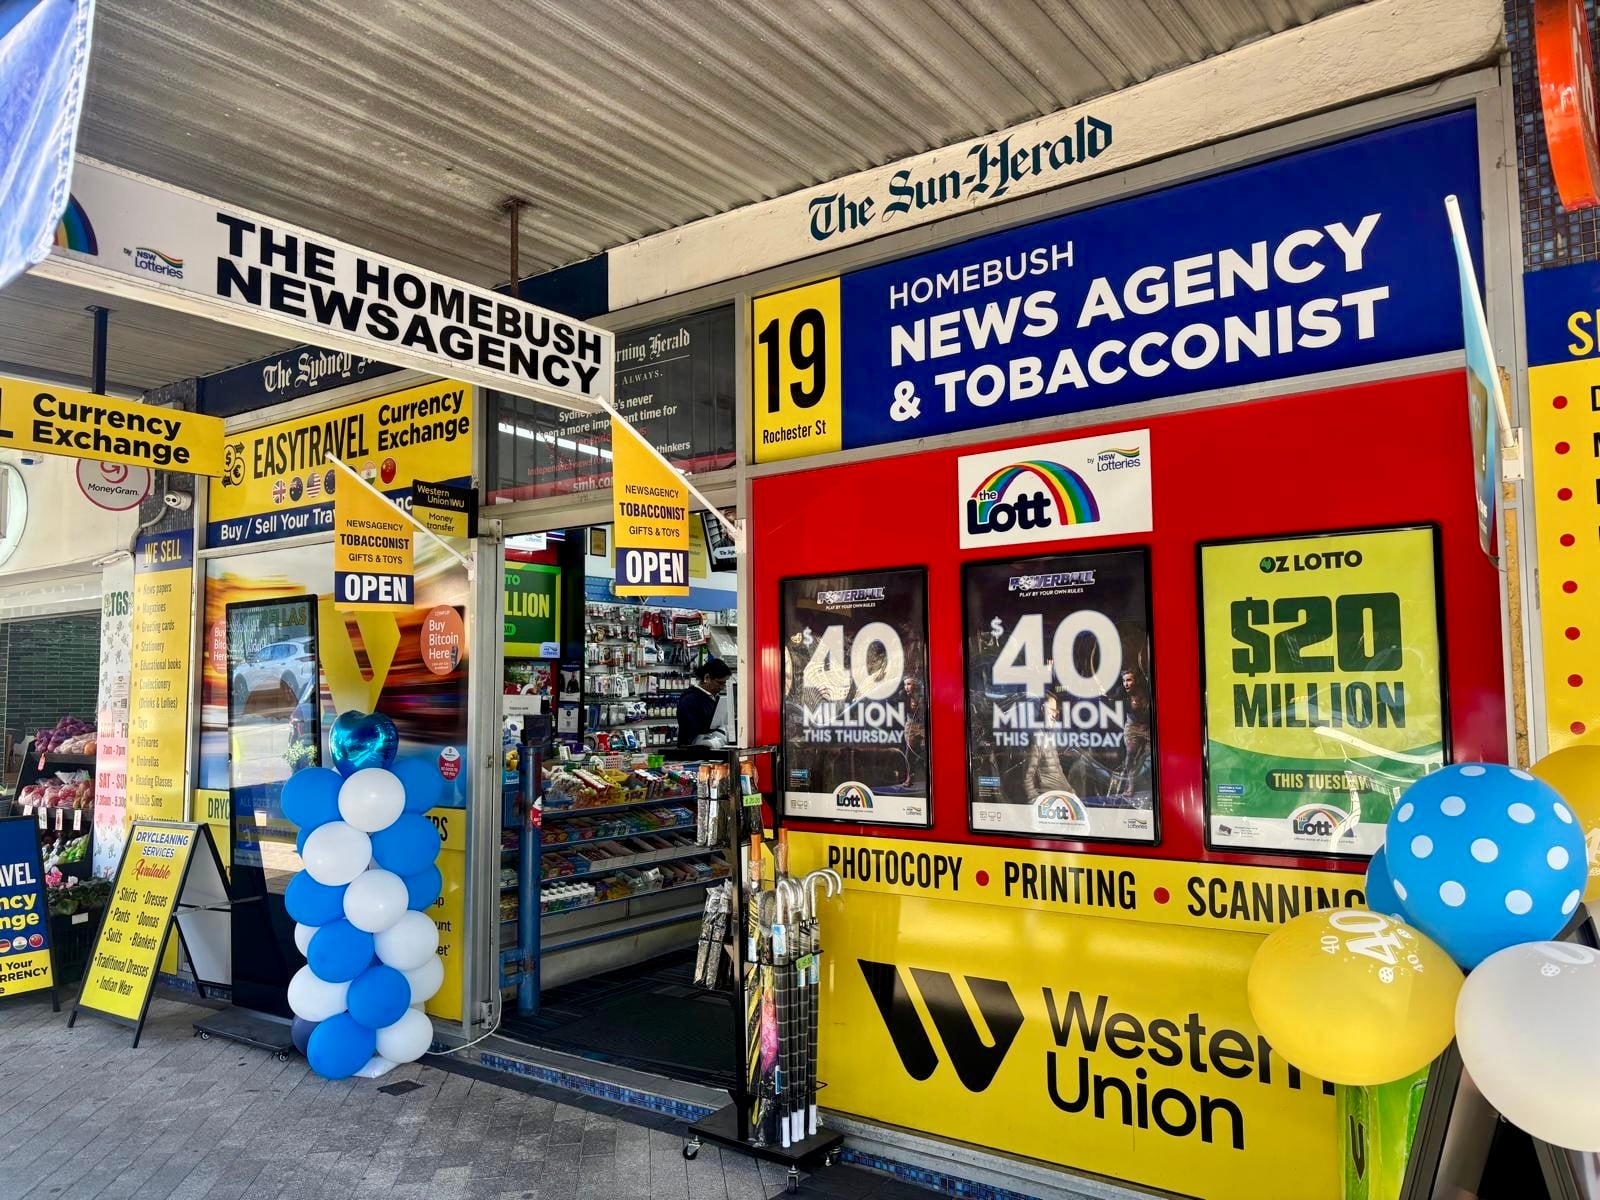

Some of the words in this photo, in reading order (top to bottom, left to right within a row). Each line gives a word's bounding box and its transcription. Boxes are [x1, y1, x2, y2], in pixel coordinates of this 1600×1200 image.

[808, 192, 875, 241] The
[882, 116, 1112, 222] Sun-Herald
[136, 250, 156, 261] NSW
[134, 257, 184, 280] Lotteries
[890, 241, 1074, 309] HOMEBUSH
[217, 212, 335, 285] THE
[356, 259, 601, 364] HOMEBUSH
[891, 290, 1059, 367] NEWS
[1077, 212, 1381, 328] AGENCY
[217, 256, 599, 395] NEWSAGENCY
[615, 344, 646, 362] rning
[649, 328, 690, 360] Herald
[889, 380, 921, 422] &
[934, 285, 1389, 413] TOBACCONIST
[758, 308, 826, 414] 19
[263, 359, 291, 394] The
[295, 351, 351, 387] Sydney
[378, 389, 464, 426] Currency
[626, 394, 653, 408] never
[33, 393, 181, 441] Currency
[560, 428, 566, 436] a
[567, 423, 590, 434] more
[640, 409, 662, 420] time
[663, 405, 677, 416] for
[33, 420, 190, 465] Exchange
[763, 425, 812, 444] Rochester
[816, 420, 827, 435] St
[254, 414, 369, 480] EASYTRAVEL
[378, 416, 470, 451] Exchange
[656, 442, 690, 454] thinkers
[1097, 457, 1140, 472] Lotteries
[417, 484, 449, 497] Western
[573, 476, 613, 492] smh.co
[625, 485, 679, 499] NEWSAGENCY
[979, 490, 997, 500] the
[427, 495, 449, 506] Union
[619, 502, 685, 521] TOBACCONIST
[429, 512, 453, 524] Money
[967, 491, 1052, 534] Lott
[221, 522, 242, 543] Buy
[244, 518, 253, 539] /
[255, 515, 277, 534] Sell
[280, 510, 310, 529] Your
[346, 520, 403, 531] NEWSAGENCY
[427, 522, 455, 532] transfer
[629, 525, 653, 535] GIFTS
[655, 527, 661, 536] &
[662, 527, 680, 538] TOYS
[145, 541, 158, 564] WE
[160, 539, 181, 562] SELL
[340, 533, 410, 550] TOBACCONIST
[348, 553, 373, 563] GIFTS
[375, 555, 381, 563] &
[383, 555, 403, 565] TOYS
[625, 550, 684, 583] OPEN
[1259, 555, 1289, 573] OZ
[1294, 550, 1363, 572] LOTTO
[156, 583, 172, 594] papers
[344, 574, 407, 602] OPEN
[1008, 570, 1097, 591] POWERBALL
[504, 591, 549, 618] LLION
[162, 620, 174, 631] cards
[429, 620, 445, 632] Buy
[1230, 592, 1403, 677] $20
[429, 632, 458, 646] Bitcoin
[167, 660, 181, 670] books
[429, 648, 449, 660] Here
[803, 621, 904, 701] $40
[990, 609, 1123, 699] $40
[803, 701, 906, 727] MILLION
[992, 700, 1125, 729] MILLION
[1233, 681, 1406, 728] MILLION
[803, 730, 831, 742] THIS
[835, 729, 904, 743] THURSDAY
[993, 732, 1029, 747] THIS
[1033, 731, 1124, 748] THURSDAY
[1273, 773, 1303, 788] THIS
[1307, 773, 1367, 791] TUESDAY
[136, 831, 189, 845] DRYCLEANING
[1293, 819, 1332, 836] Lott
[143, 846, 175, 858] SERVICES
[131, 858, 170, 880] Available
[828, 845, 962, 891] PHOTOCOPY
[1004, 861, 1136, 910] PRINTING
[119, 888, 138, 903] Shirts
[144, 890, 168, 907] Dresses
[112, 909, 130, 924] Pants
[138, 912, 160, 928] Doonas
[106, 928, 122, 944] Suits
[131, 931, 157, 951] Blankets
[6, 960, 33, 971] Your
[96, 954, 126, 972] Traditional
[127, 959, 149, 978] Dresses
[99, 978, 117, 992] Indian
[118, 979, 133, 996] Wear
[1047, 1051, 1244, 1150] Union
